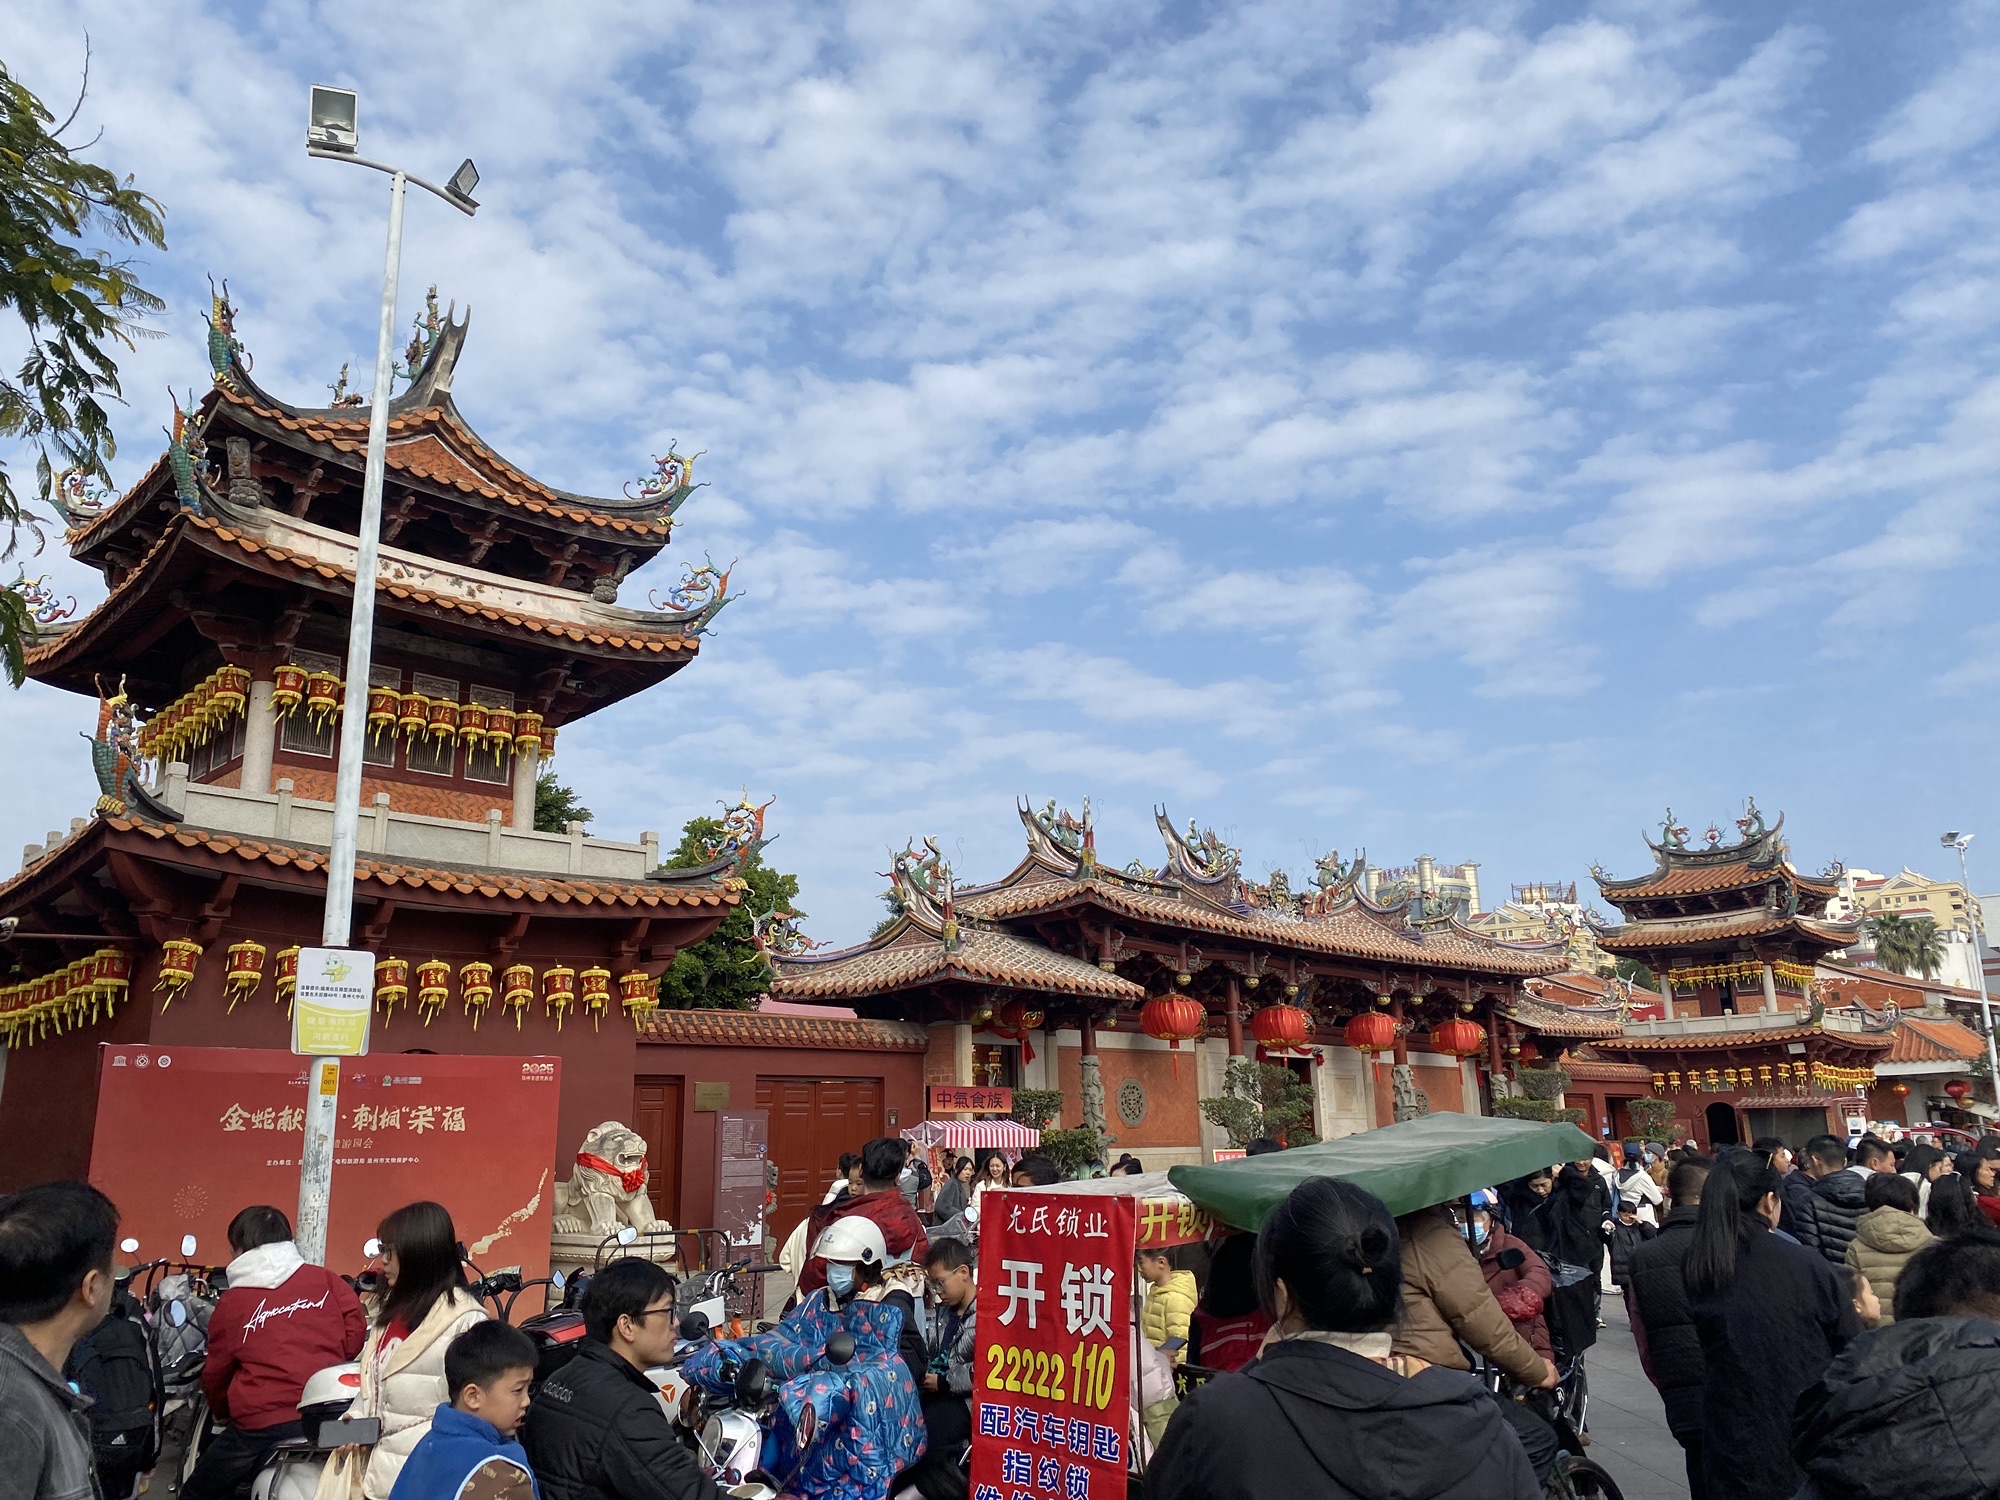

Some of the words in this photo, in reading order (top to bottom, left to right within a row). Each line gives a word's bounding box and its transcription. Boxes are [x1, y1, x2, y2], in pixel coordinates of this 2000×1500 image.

[522, 1063, 554, 1074] 2025
[937, 1090, 1003, 1109] 中氣食族
[1006, 1204, 1109, 1239] 尤氏锁业
[997, 1259, 1115, 1339] 开锁
[979, 1402, 1121, 1463] 配汽车钥匙
[1002, 1449, 1091, 1500] 指纹锁
